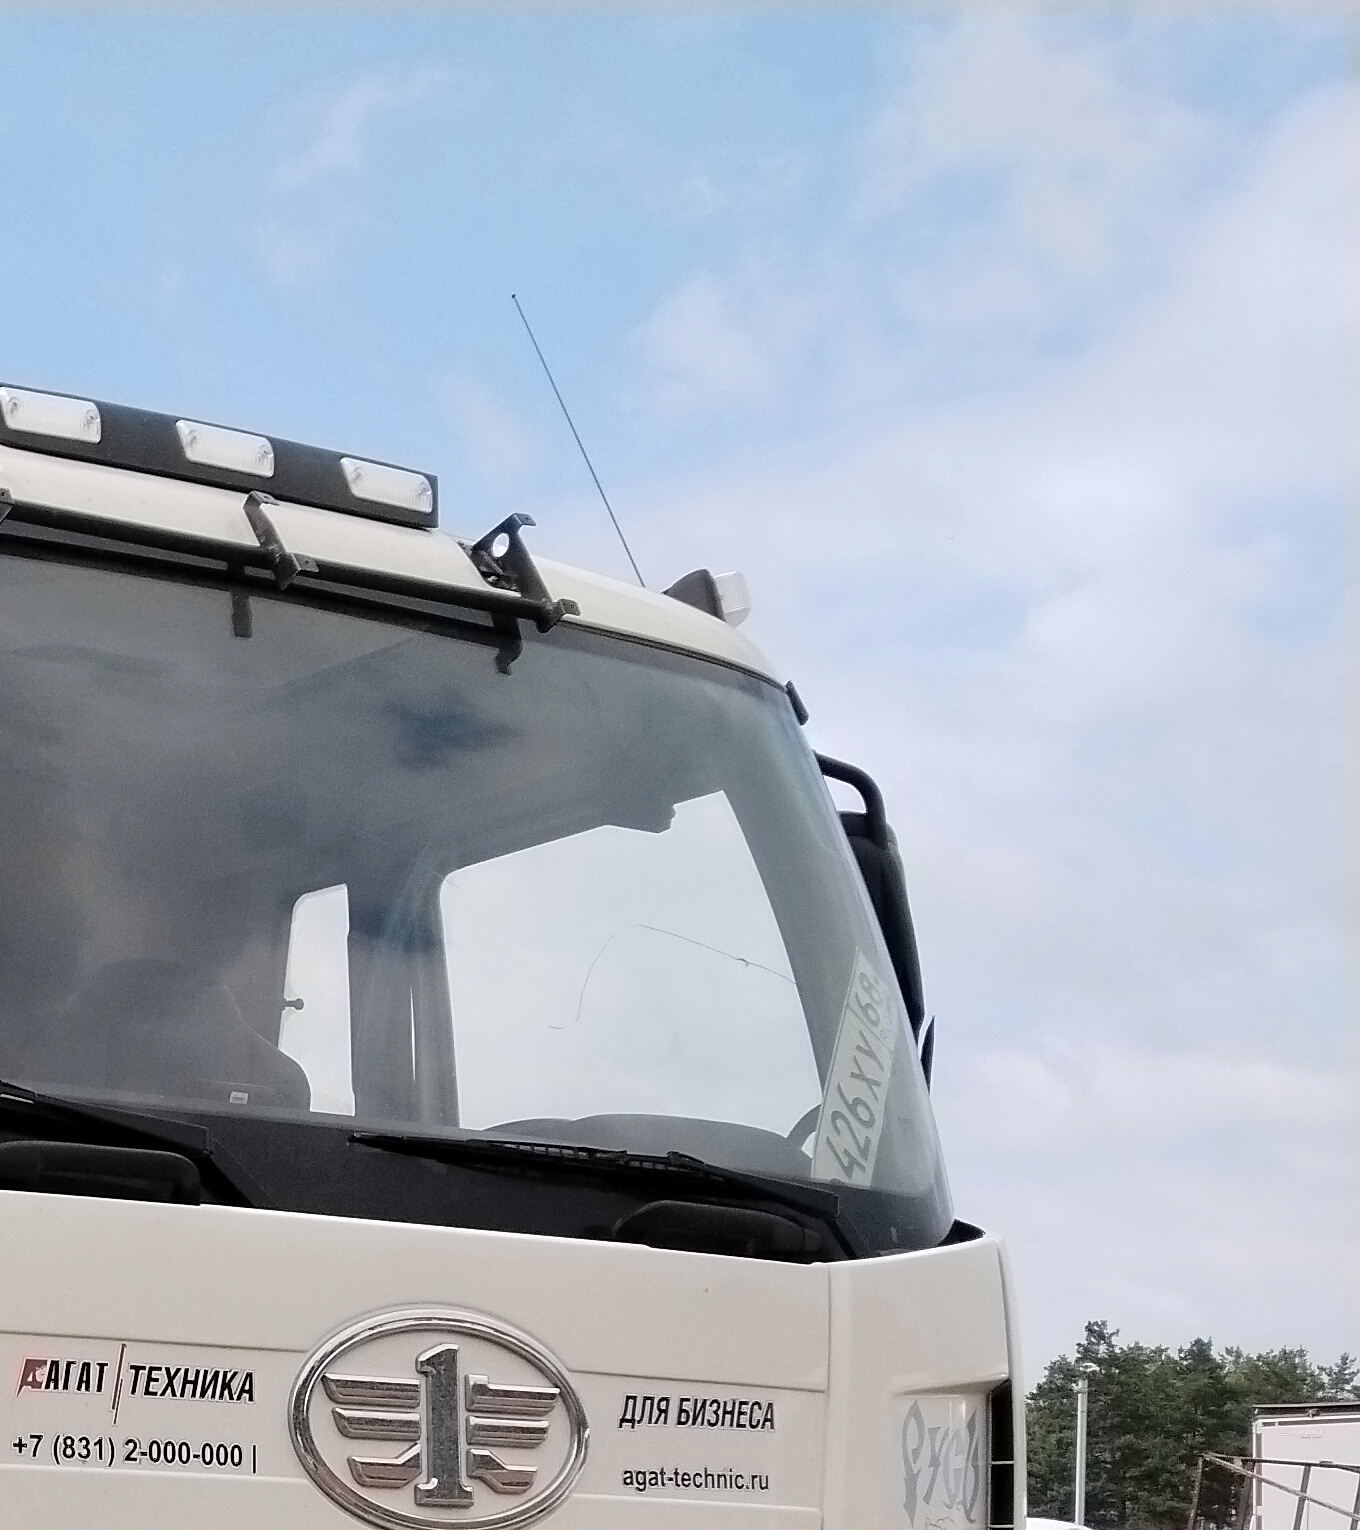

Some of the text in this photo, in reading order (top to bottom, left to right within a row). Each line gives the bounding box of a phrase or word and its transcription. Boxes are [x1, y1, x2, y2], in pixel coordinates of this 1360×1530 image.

[129, 1364, 255, 1402] ТЕХНИКА
[618, 1394, 775, 1430] ДЛЯ БИЗНЕСА
[12, 1434, 244, 1468] +7 (831) 2-000-000
[622, 1466, 770, 1493] agat-technic.ru
